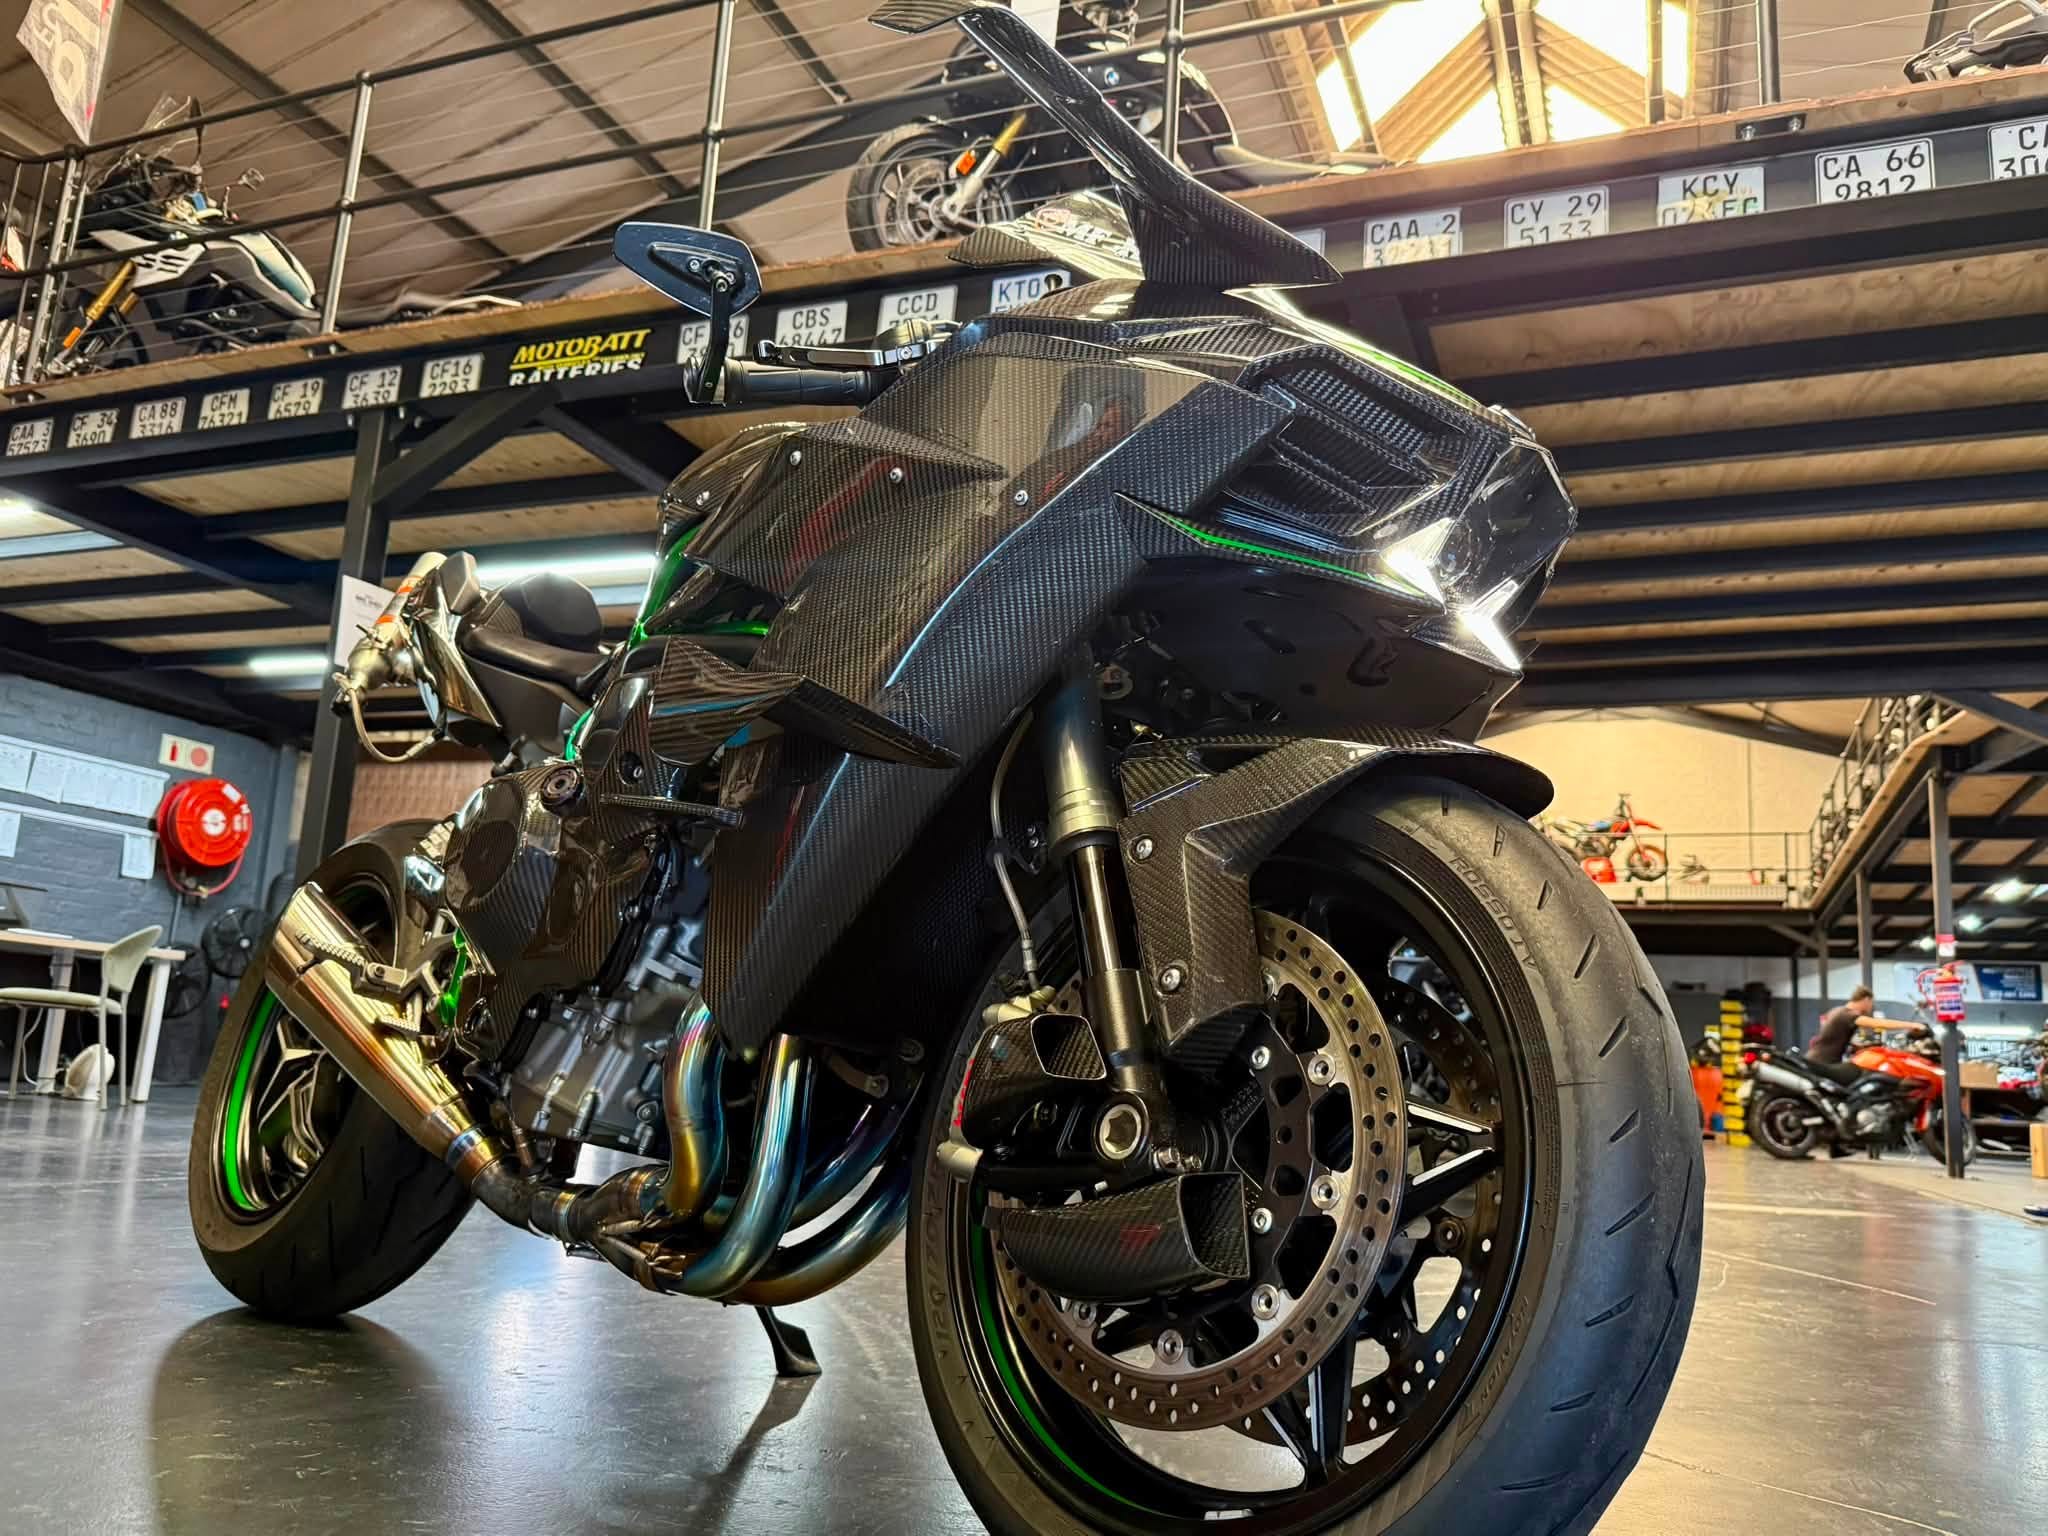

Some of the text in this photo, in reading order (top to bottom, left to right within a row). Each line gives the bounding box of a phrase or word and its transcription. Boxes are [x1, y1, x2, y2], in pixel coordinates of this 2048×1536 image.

[2019, 126, 2048, 150] C
[1823, 145, 1925, 180] CA 66
[1999, 155, 2048, 178] 30
[1683, 172, 1738, 201] KCY
[1835, 175, 1916, 201] 9812
[1511, 193, 1601, 224] CY 29
[1371, 214, 1457, 245] CAA 2
[897, 293, 938, 315] CCD
[792, 307, 831, 330] CBS
[512, 328, 651, 364] MOTOBATT
[682, 325, 706, 345] CF
[350, 370, 398, 392] CF 12
[509, 357, 644, 386] BATTERIES
[211, 394, 238, 412] CFM
[273, 381, 320, 402] CF 19
[1448, 856, 1515, 932] ROSSO
